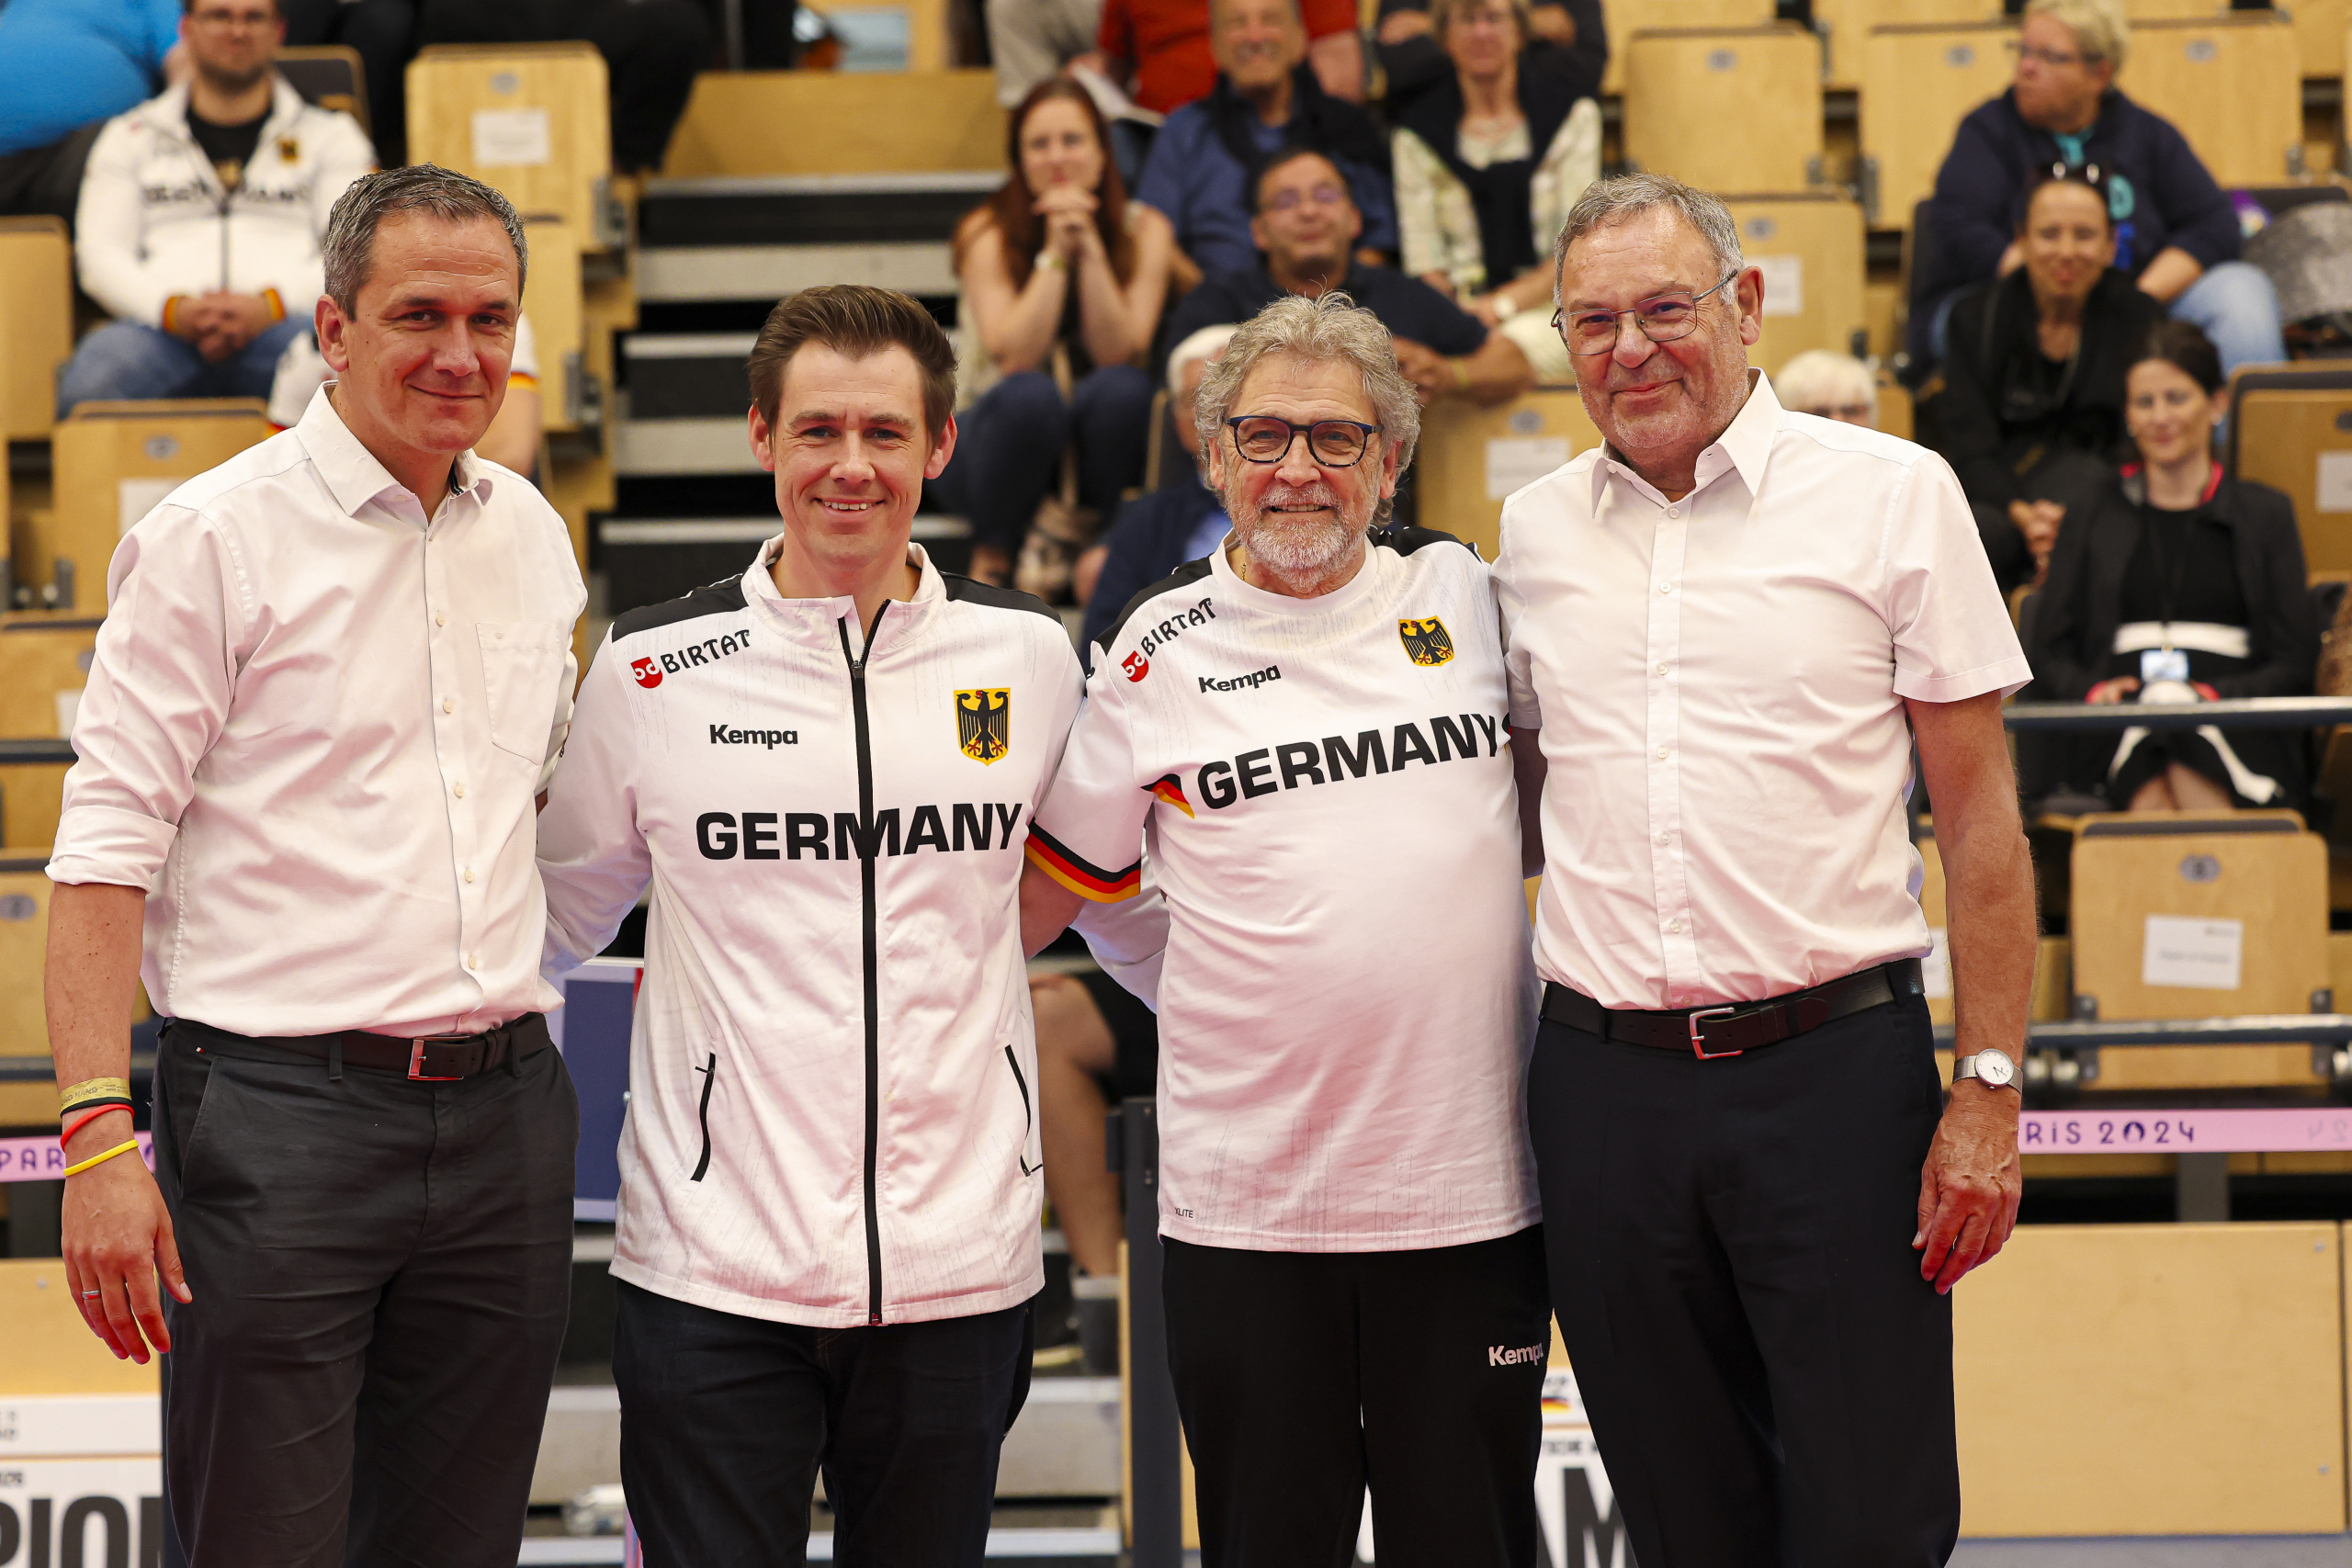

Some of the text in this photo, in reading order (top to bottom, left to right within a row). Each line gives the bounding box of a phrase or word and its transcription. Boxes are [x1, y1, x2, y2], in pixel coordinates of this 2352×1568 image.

[1141, 598, 1216, 658] BIRTAT
[660, 629, 751, 674] BIRTAT
[1198, 665, 1282, 694] Kempa
[709, 724, 798, 750] Kempa
[1197, 714, 1498, 809] GERMANY
[695, 803, 1023, 861] GERMANY
[2098, 1121, 2195, 1144] 2024
[0, 1148, 63, 1171] PAR
